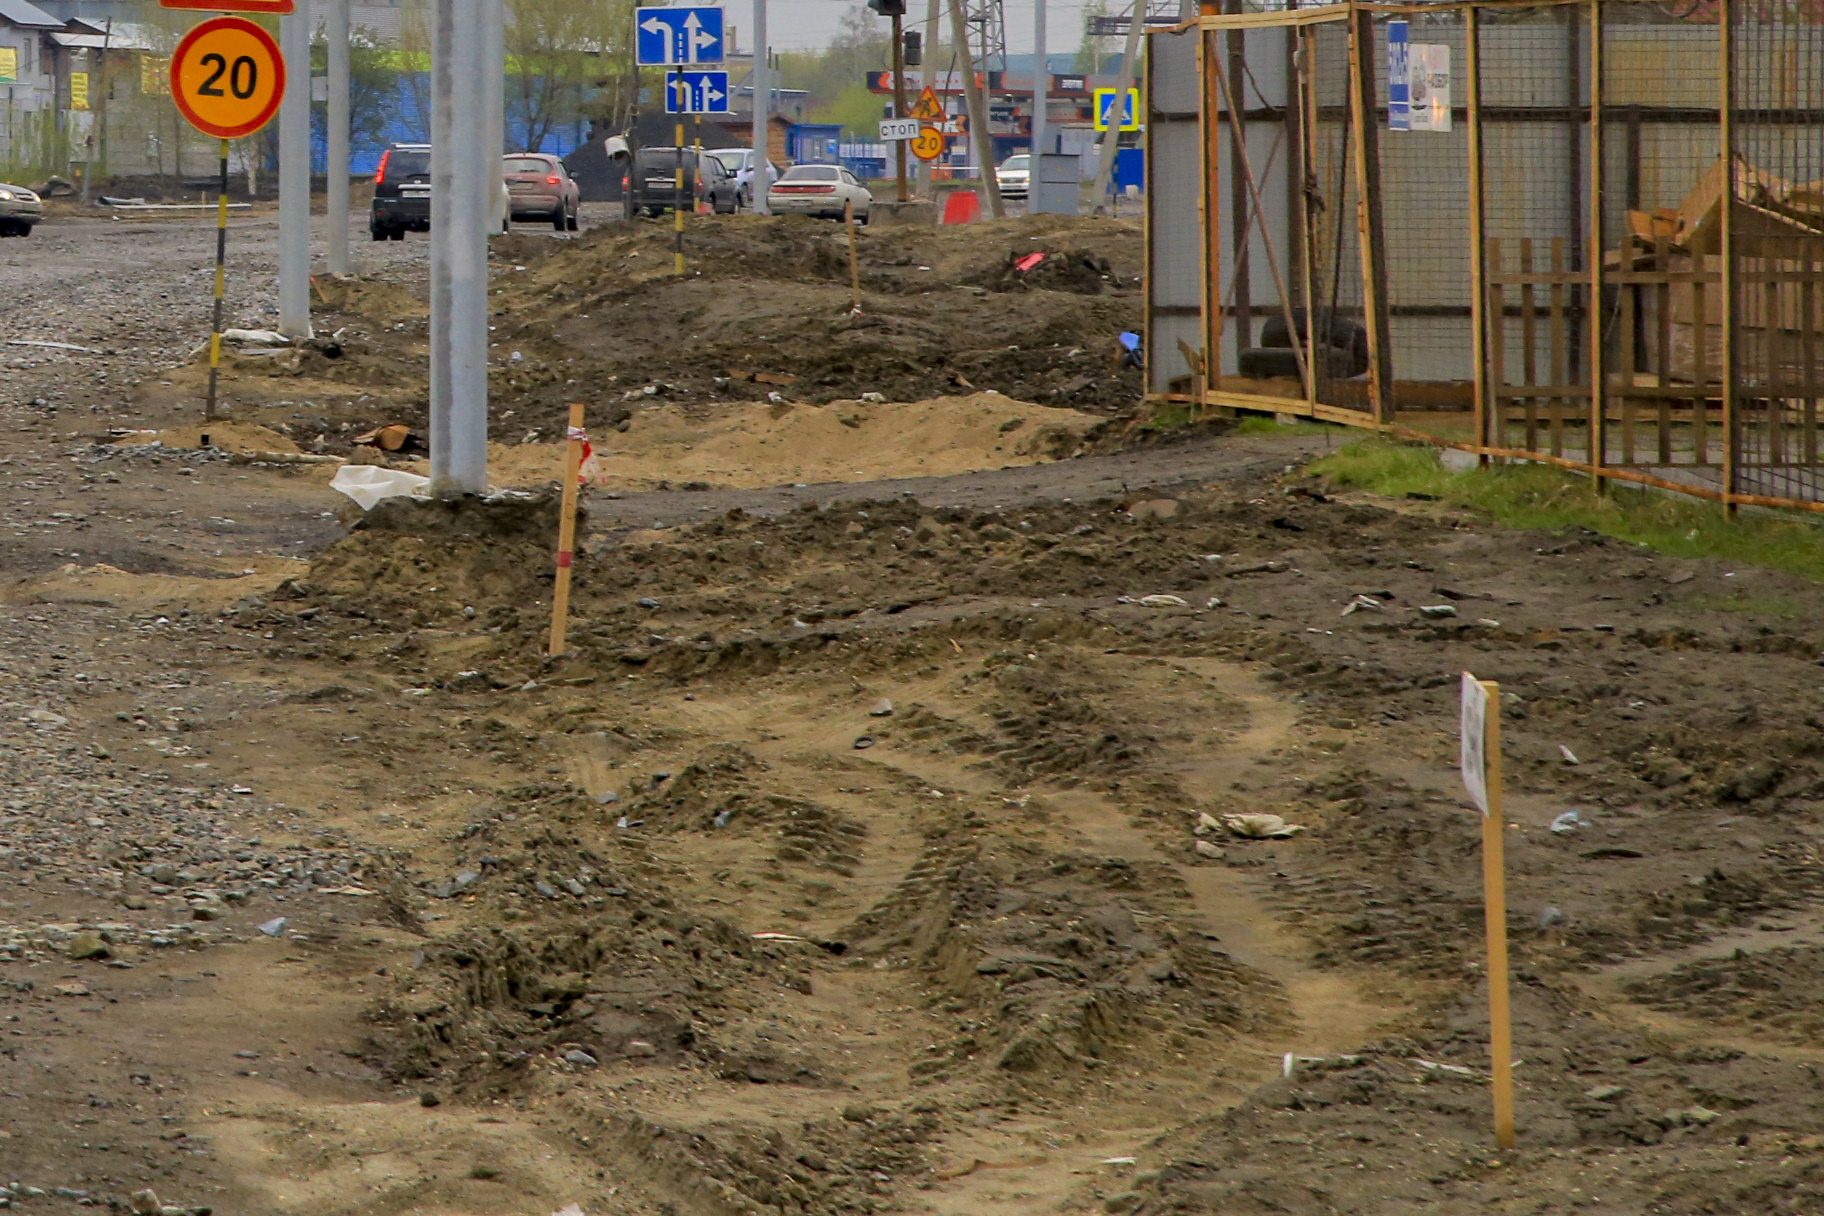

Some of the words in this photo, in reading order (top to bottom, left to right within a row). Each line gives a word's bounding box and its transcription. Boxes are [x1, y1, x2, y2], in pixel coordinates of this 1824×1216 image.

[197, 52, 257, 100] 20
[881, 123, 917, 137] СТОП
[917, 135, 938, 150] 20
